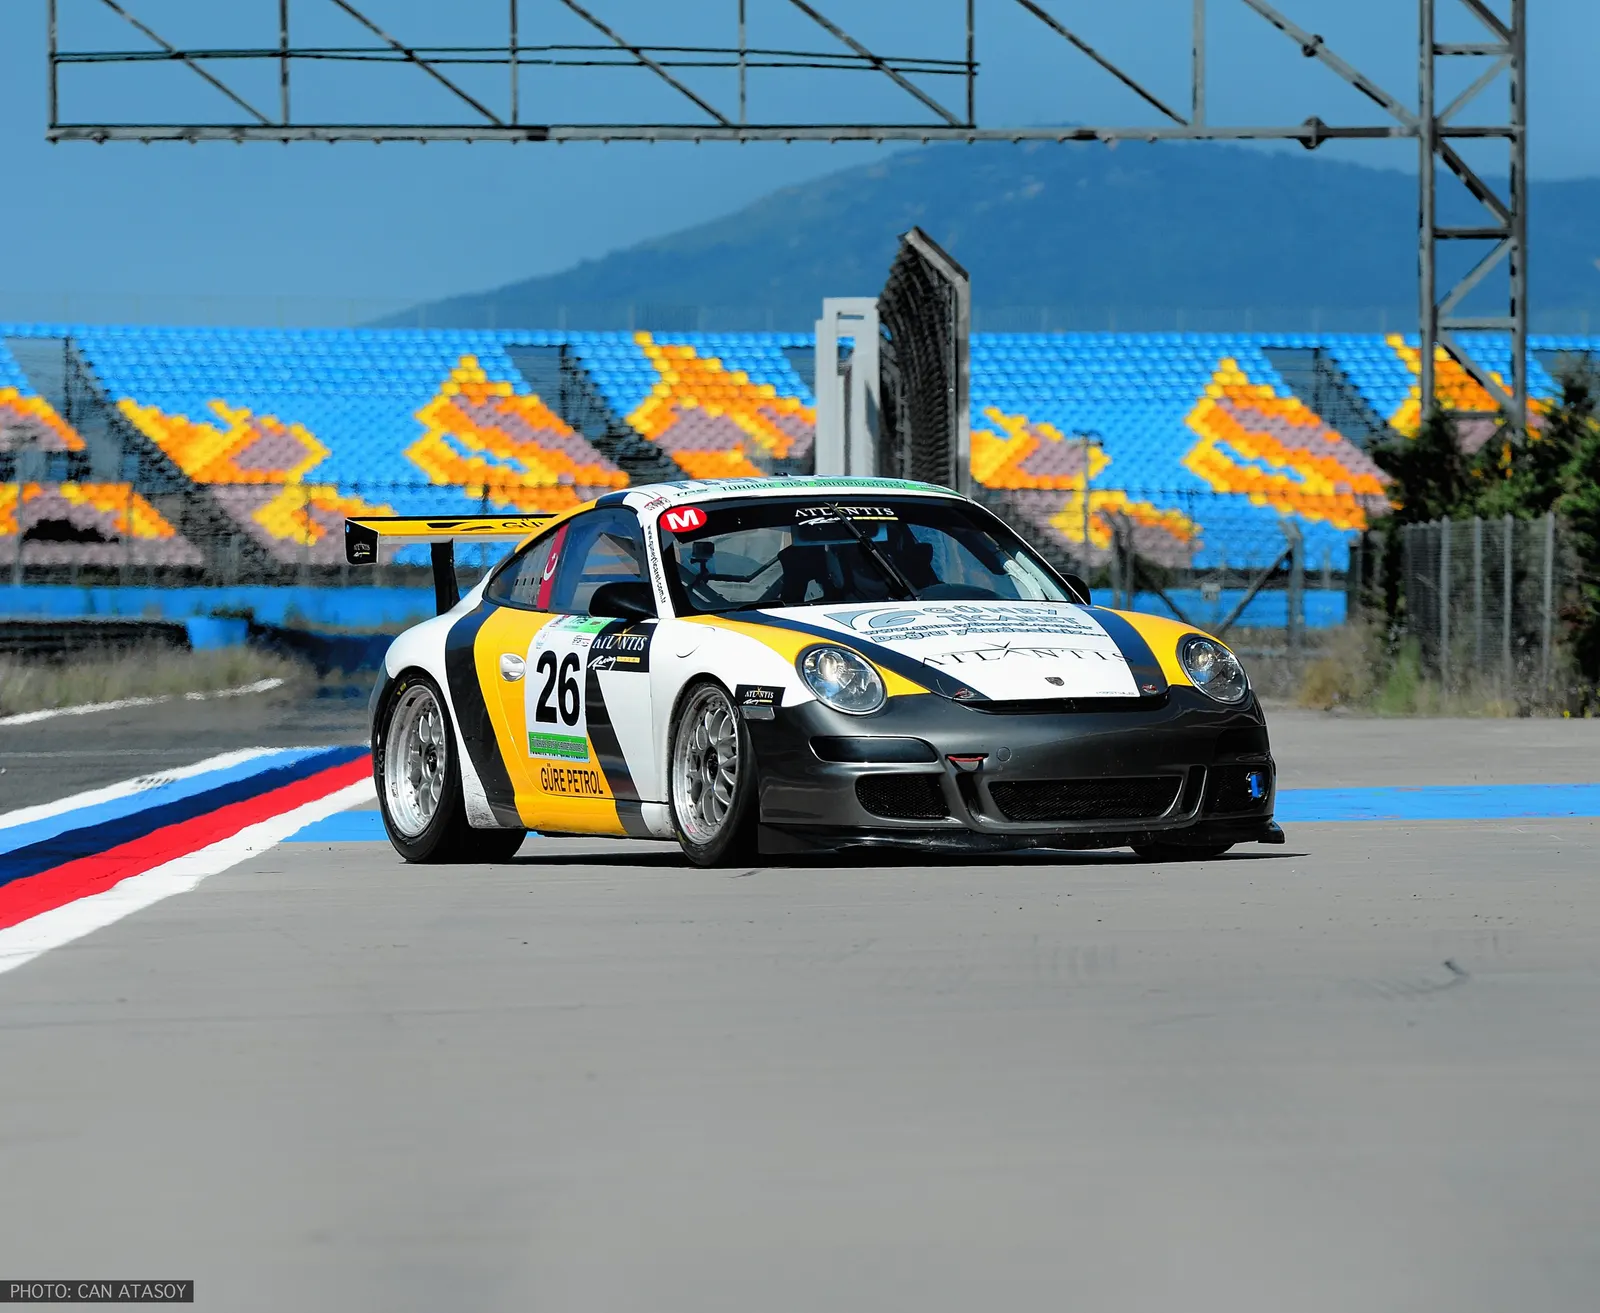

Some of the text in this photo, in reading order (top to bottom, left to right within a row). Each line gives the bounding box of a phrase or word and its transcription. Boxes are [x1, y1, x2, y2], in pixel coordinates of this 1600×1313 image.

[666, 509, 700, 530] M
[591, 633, 648, 651] ATLANTIS
[871, 630, 949, 643] Doğru
[921, 646, 1134, 668] ATLANTIS
[535, 650, 580, 726] 26
[744, 689, 774, 699] ATLANTIS
[540, 763, 603, 794] GÜRE PETROL
